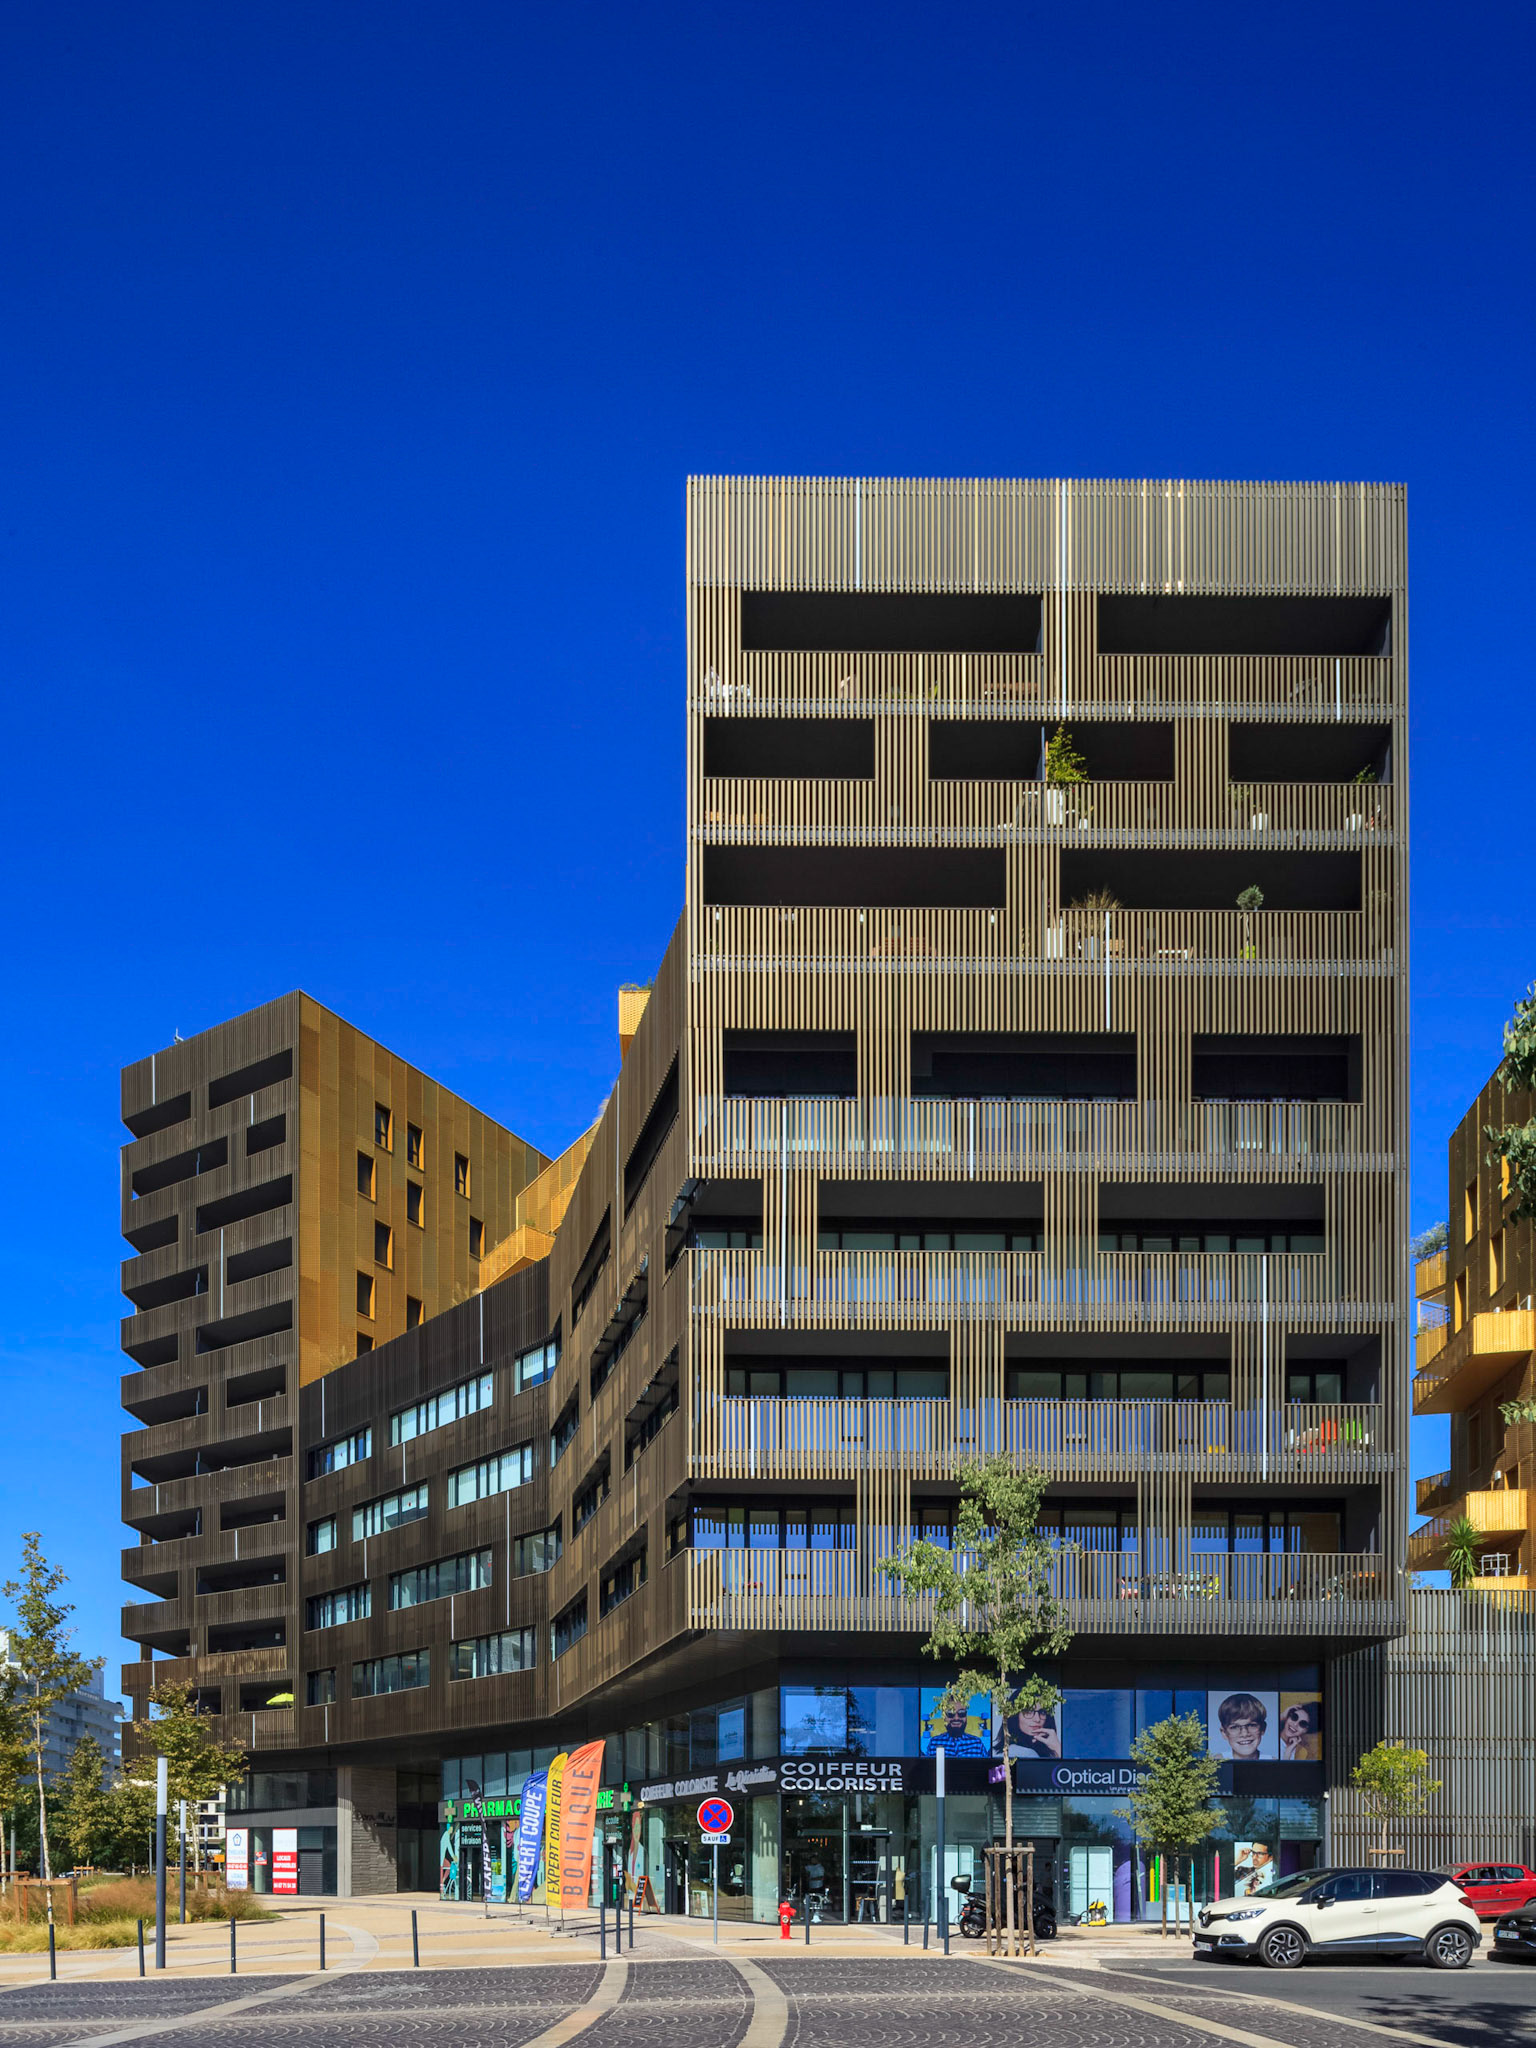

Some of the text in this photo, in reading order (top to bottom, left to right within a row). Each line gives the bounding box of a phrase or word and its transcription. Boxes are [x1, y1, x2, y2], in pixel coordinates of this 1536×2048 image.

[781, 1762, 903, 1776] COIFFEUR
[781, 1777, 903, 1791] COLORISTE
[1056, 1768, 1116, 1787] Optical
[640, 1776, 719, 1802] COIFFEUR COLORISTE
[461, 1824, 482, 1832] services
[521, 1790, 543, 1836] COUPE
[549, 1779, 562, 1841] COULEUR
[563, 1769, 594, 1896] BOUTIQUE
[518, 1837, 537, 1892] EXPERT
[547, 1842, 560, 1895] EXPERT
